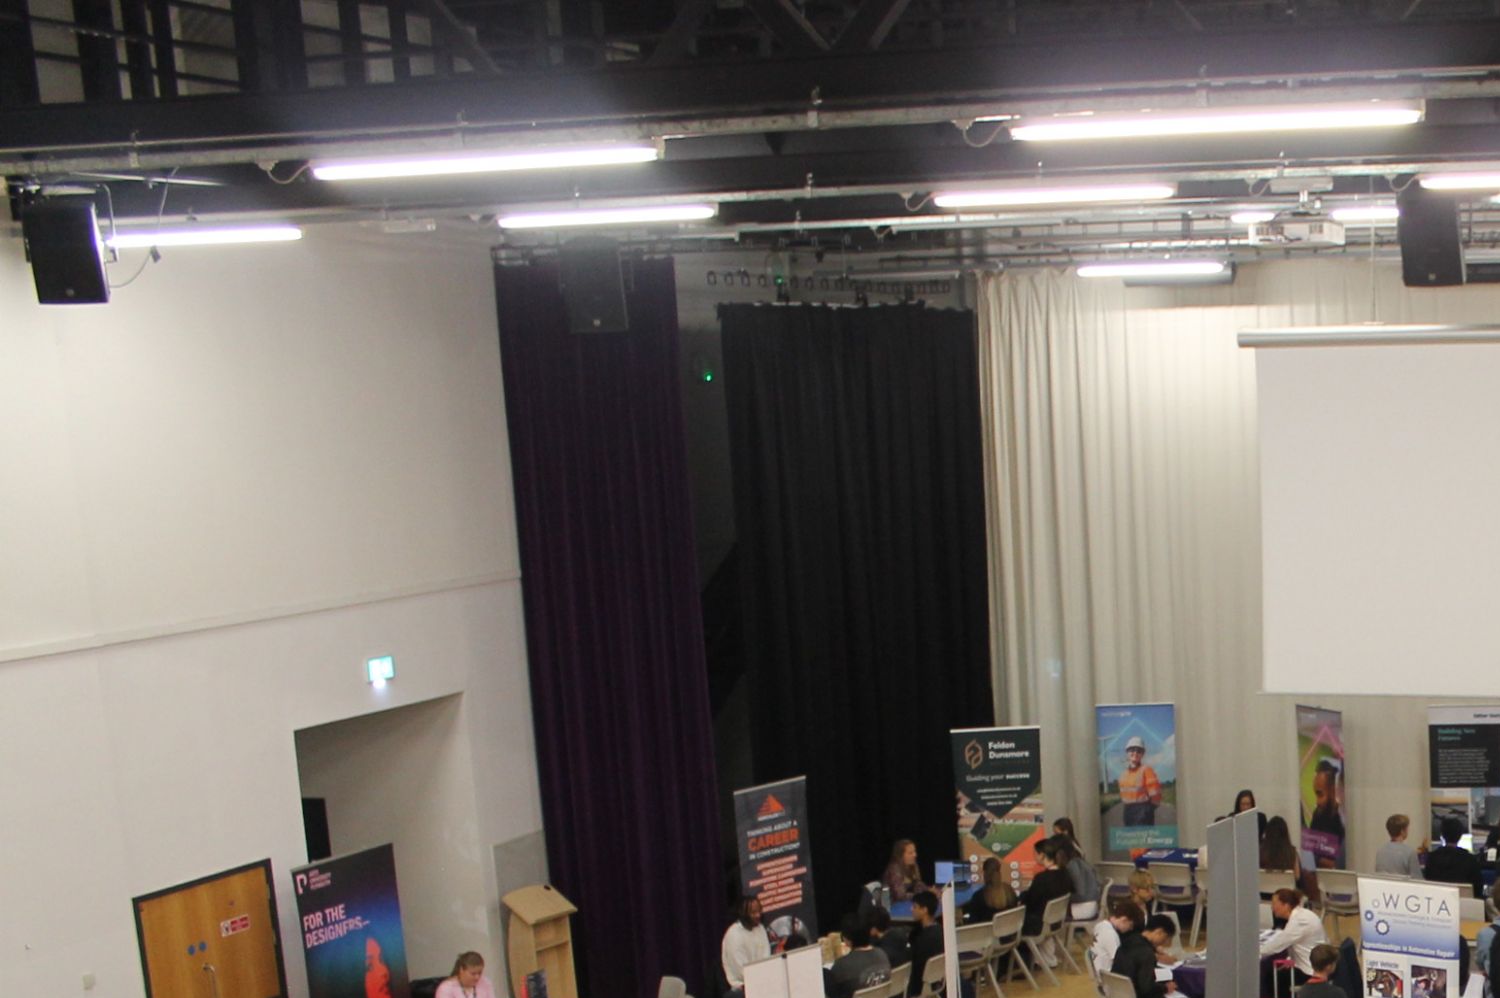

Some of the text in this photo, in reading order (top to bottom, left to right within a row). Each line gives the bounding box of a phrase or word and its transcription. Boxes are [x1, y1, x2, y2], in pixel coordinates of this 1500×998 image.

[988, 750, 1030, 760] Dunsmore
[748, 828, 800, 853] CAREER
[1382, 892, 1452, 917] WGTA
[303, 904, 347, 931] FOR THE
